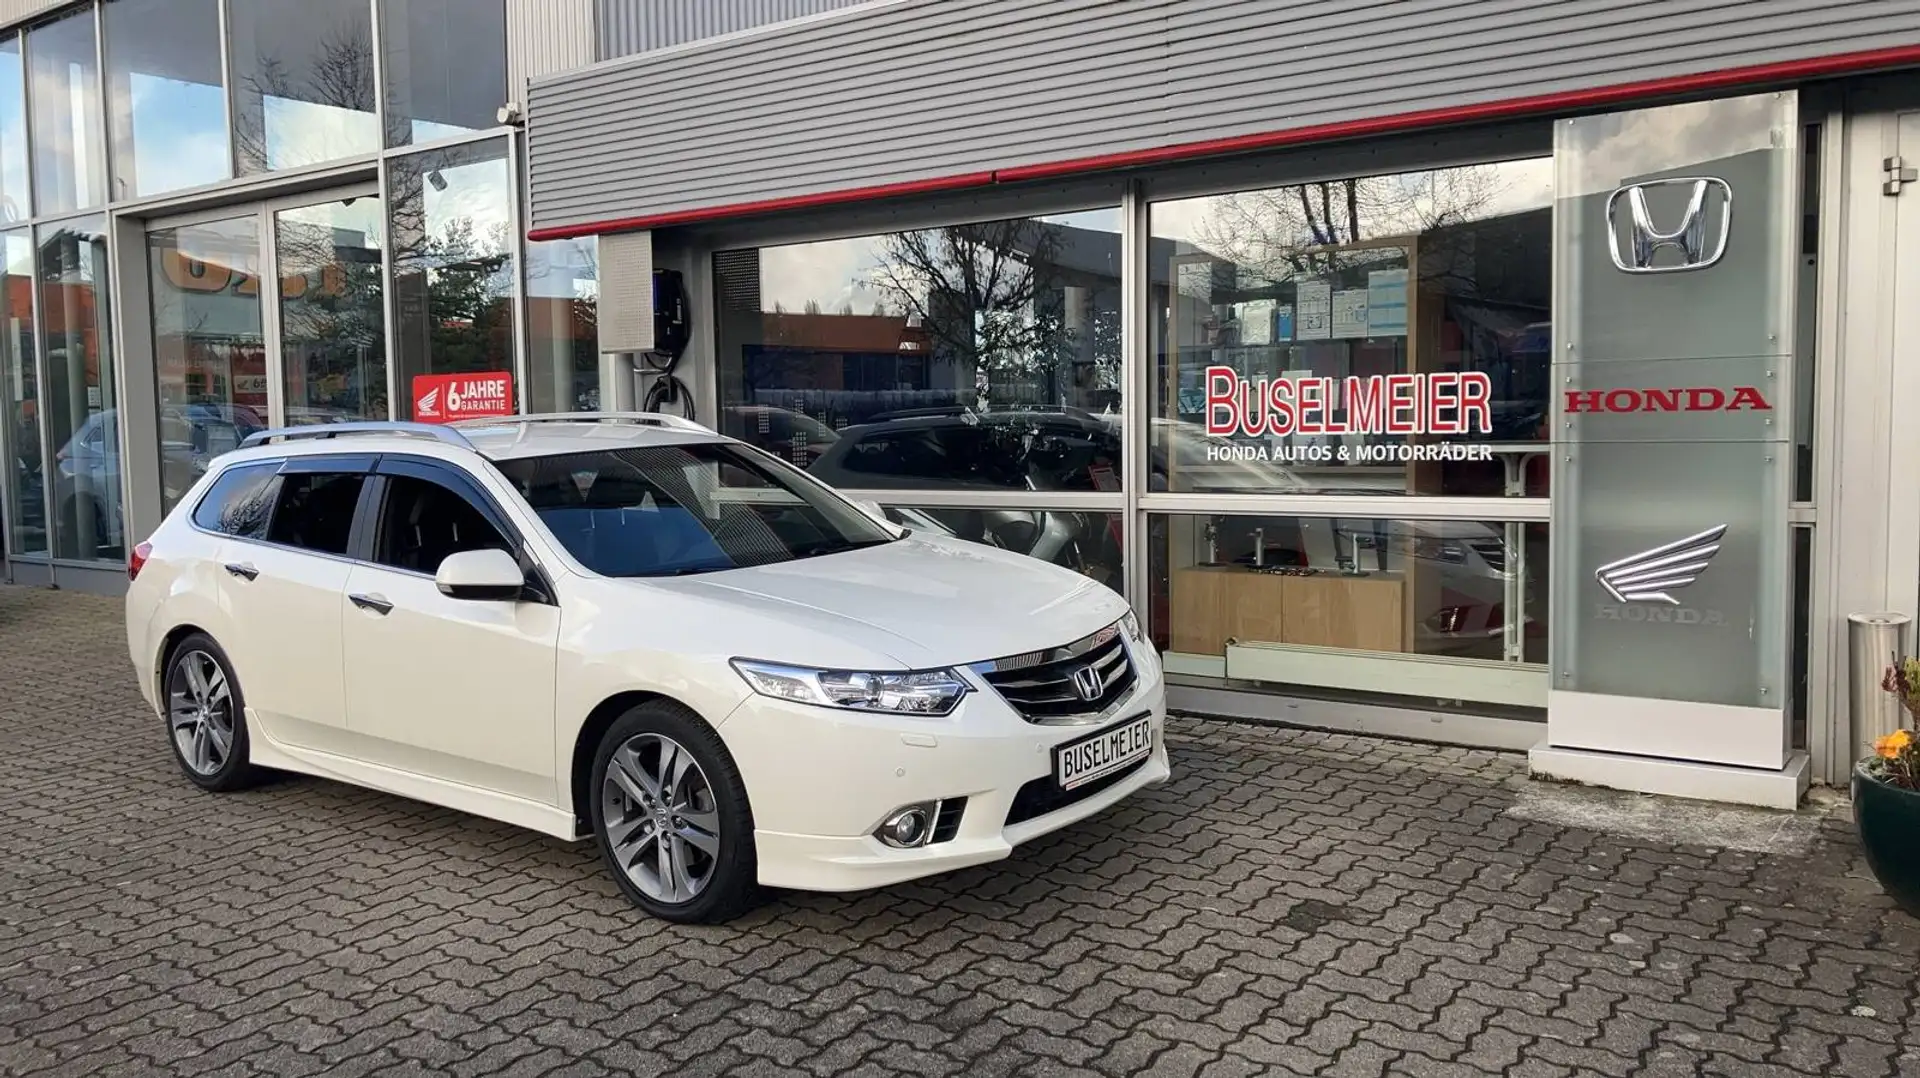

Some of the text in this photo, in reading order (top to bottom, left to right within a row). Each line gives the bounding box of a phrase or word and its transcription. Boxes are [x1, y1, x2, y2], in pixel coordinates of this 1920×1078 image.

[447, 380, 506, 411] 6 JAHRE
[460, 399, 506, 411] GARANTIE
[1205, 366, 1493, 437] BUSELMEIER
[1564, 387, 1773, 413] HONDA
[1206, 441, 1493, 462] HONDA AUTOS & MOTORRÄDER
[1594, 603, 1729, 627] HONDA
[1064, 720, 1151, 779] BUSELMEIER
